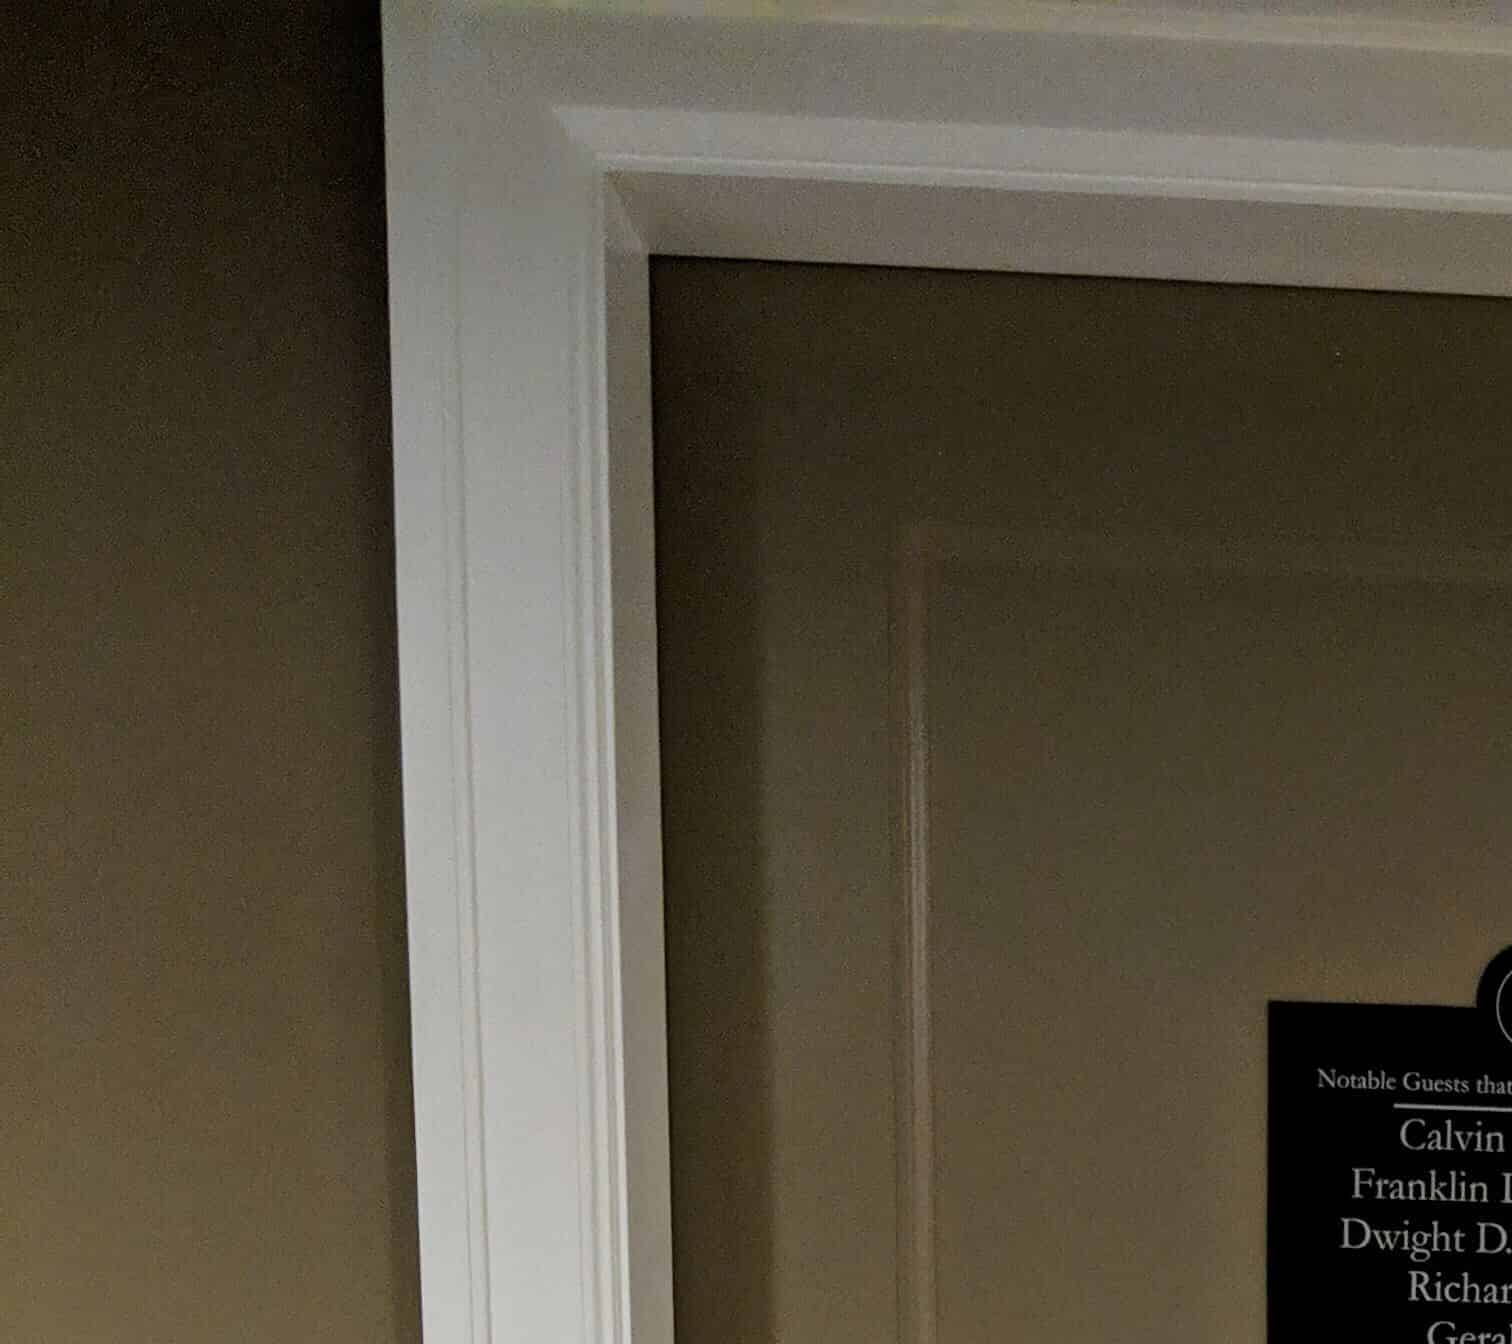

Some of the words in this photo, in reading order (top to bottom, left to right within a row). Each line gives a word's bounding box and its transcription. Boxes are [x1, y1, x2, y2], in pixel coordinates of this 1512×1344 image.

[1317, 1068, 1397, 1091] Notable
[1402, 1072, 1470, 1093] Guests
[1399, 1118, 1505, 1153] Calvin
[1351, 1167, 1489, 1203] Franklin
[1341, 1217, 1465, 1262] Dwight
[1476, 1222, 1512, 1255] D.
